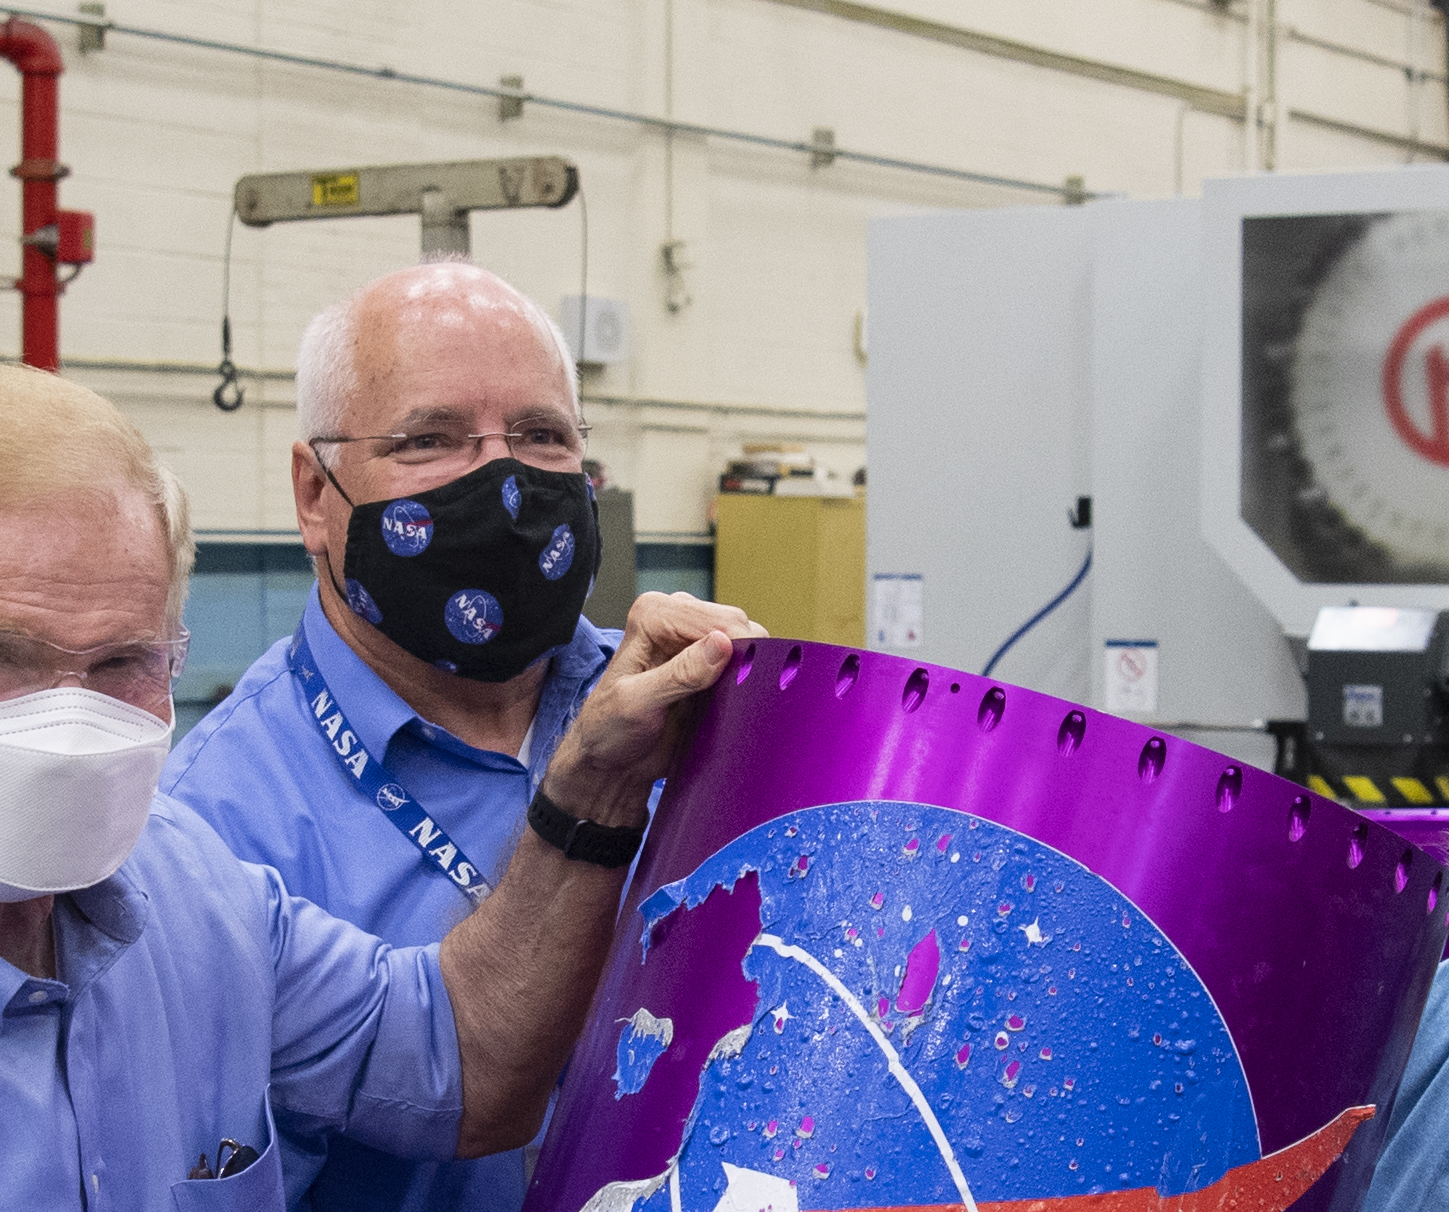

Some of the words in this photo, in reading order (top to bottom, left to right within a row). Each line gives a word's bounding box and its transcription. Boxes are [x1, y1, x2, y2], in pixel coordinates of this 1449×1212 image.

[382, 517, 428, 541] NASA
[454, 594, 494, 639] NASA
[311, 688, 369, 779] NASA
